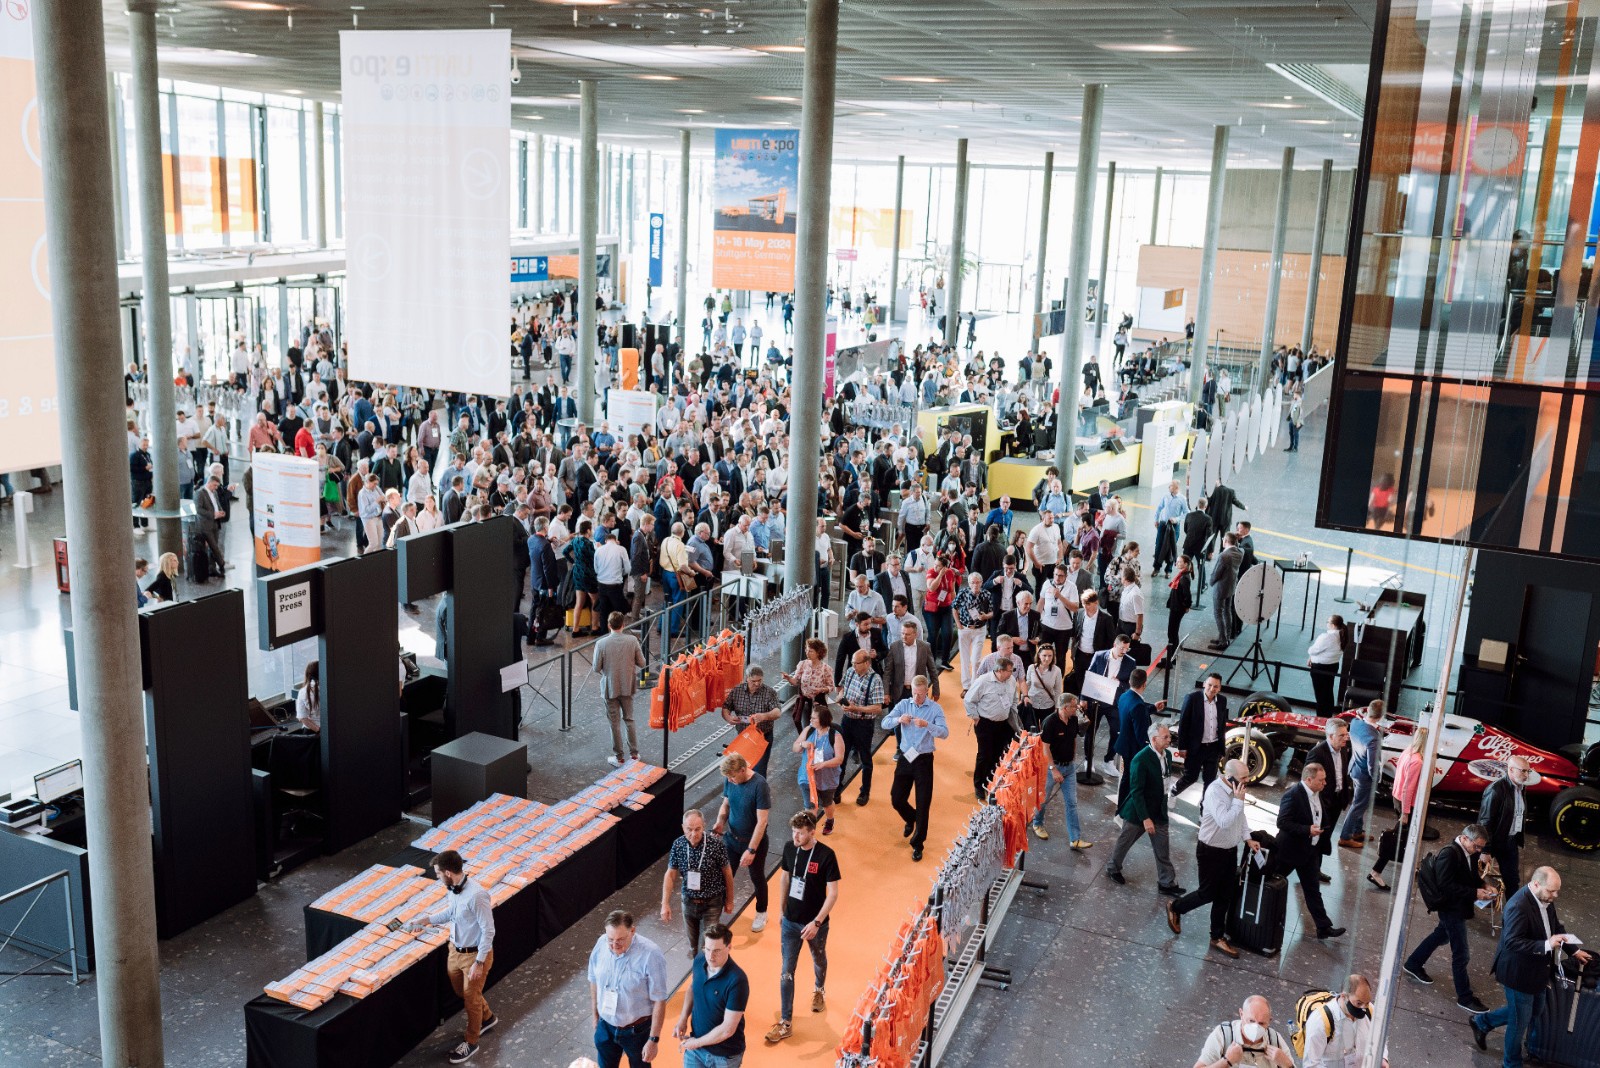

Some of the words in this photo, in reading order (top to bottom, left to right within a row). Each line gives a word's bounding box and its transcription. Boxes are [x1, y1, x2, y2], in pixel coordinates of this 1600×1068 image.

[762, 139, 795, 153] expo
[651, 228, 660, 260] Allianz
[745, 237, 765, 250] May
[767, 238, 792, 249] 2024
[715, 249, 752, 260] Stuttgart,
[754, 250, 791, 263] Germany
[1281, 269, 1326, 281] REGIN
[279, 589, 307, 602] Presse
[279, 600, 303, 613] Press
